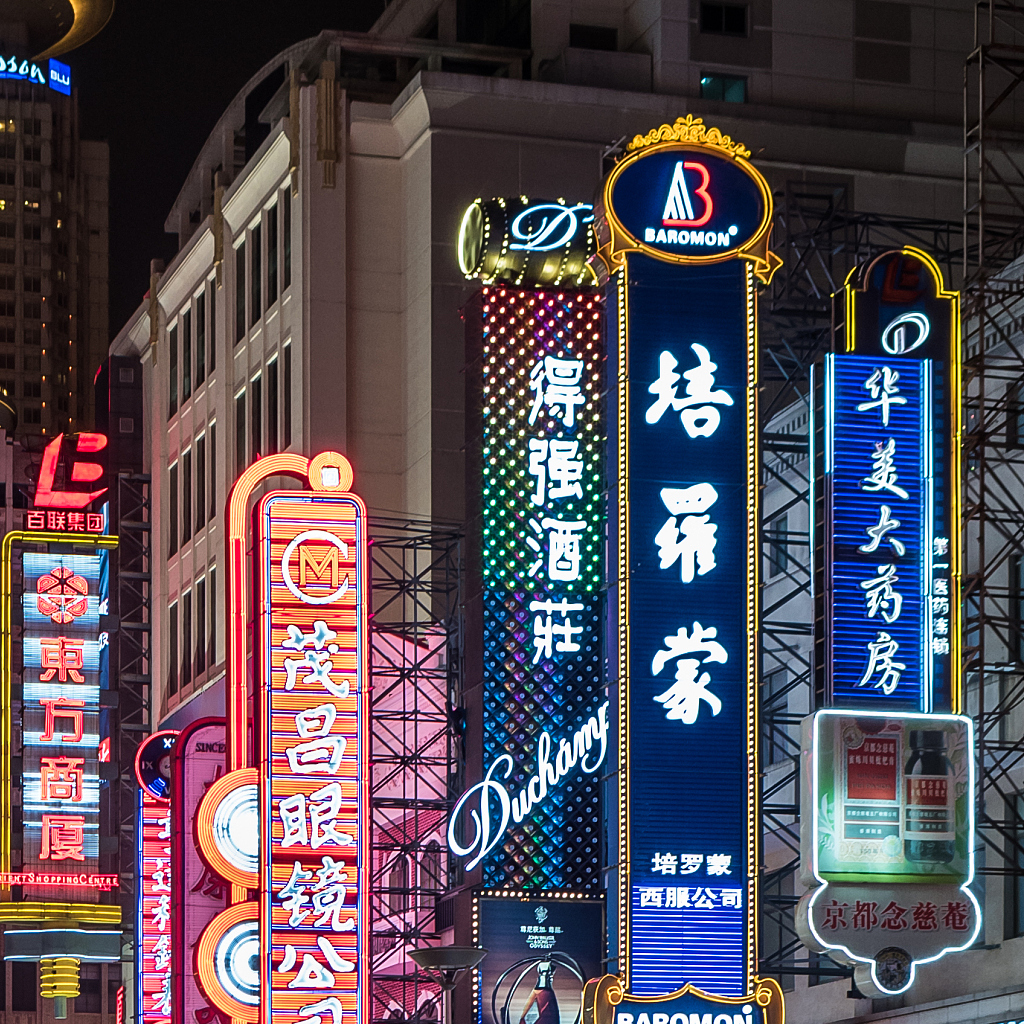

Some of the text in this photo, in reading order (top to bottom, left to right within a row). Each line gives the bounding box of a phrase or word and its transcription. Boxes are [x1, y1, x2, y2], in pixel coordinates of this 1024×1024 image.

[50, 68, 70, 87] BLU
[644, 226, 730, 247] BAROMON
[26, 510, 105, 532] 百联集团
[856, 365, 909, 696] 华美大药房
[38, 635, 86, 862] 東方商厦
[651, 852, 733, 876] 培罗蒙
[638, 886, 743, 910] 西服公司
[821, 900, 971, 932] 京都念慈菴
